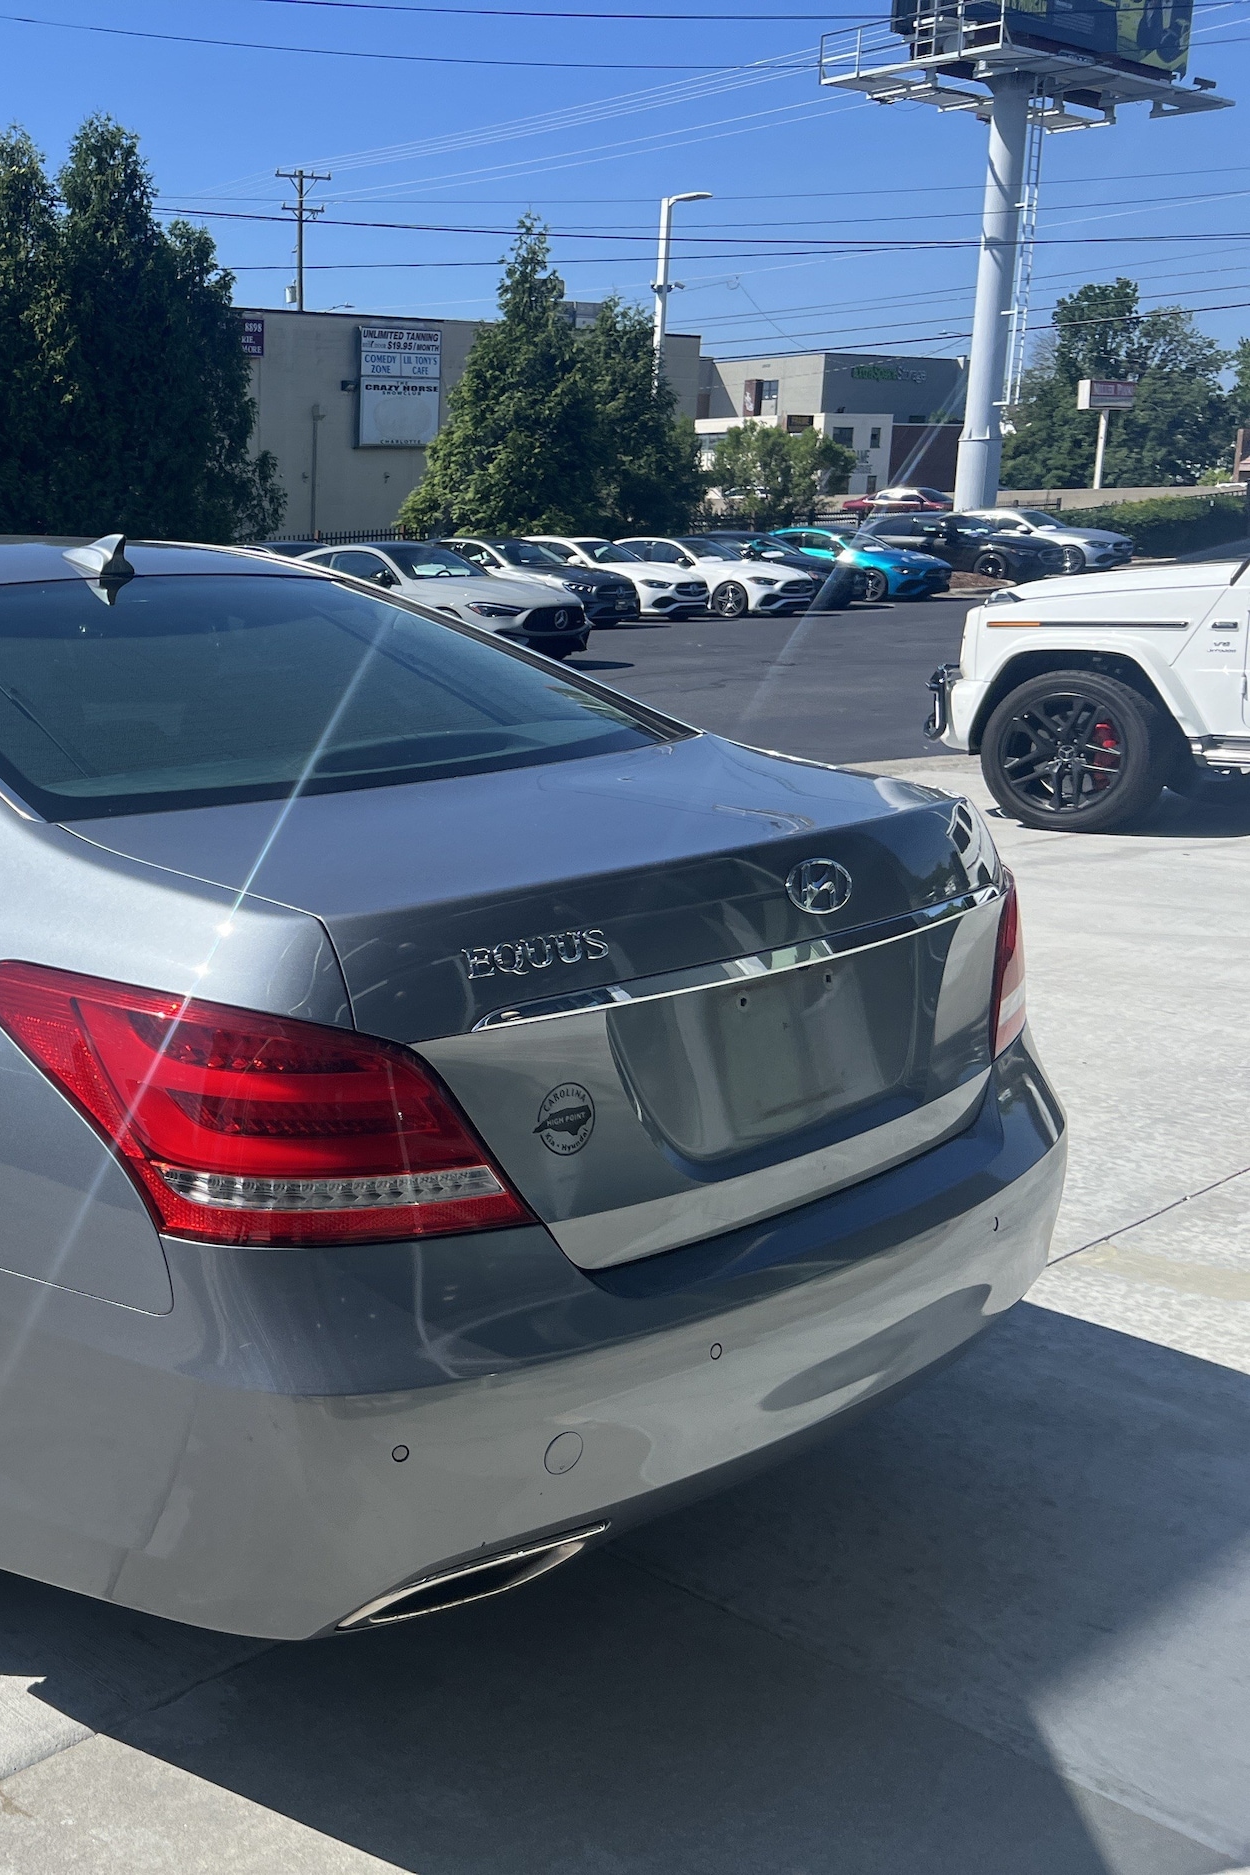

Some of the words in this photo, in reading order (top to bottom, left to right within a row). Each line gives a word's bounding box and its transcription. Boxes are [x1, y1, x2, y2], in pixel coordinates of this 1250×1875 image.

[363, 330, 404, 340] UNLIMITED
[406, 332, 439, 342] TANNING
[364, 354, 397, 363] COMEDY
[371, 364, 391, 374] ZONE
[412, 366, 429, 375] CAFE
[365, 384, 400, 392] CRAZY
[461, 928, 609, 980] EQUUS
[543, 1088, 587, 1112] CAROLINA
[546, 1117, 565, 1127] HIGH
[565, 1111, 587, 1122] POINT
